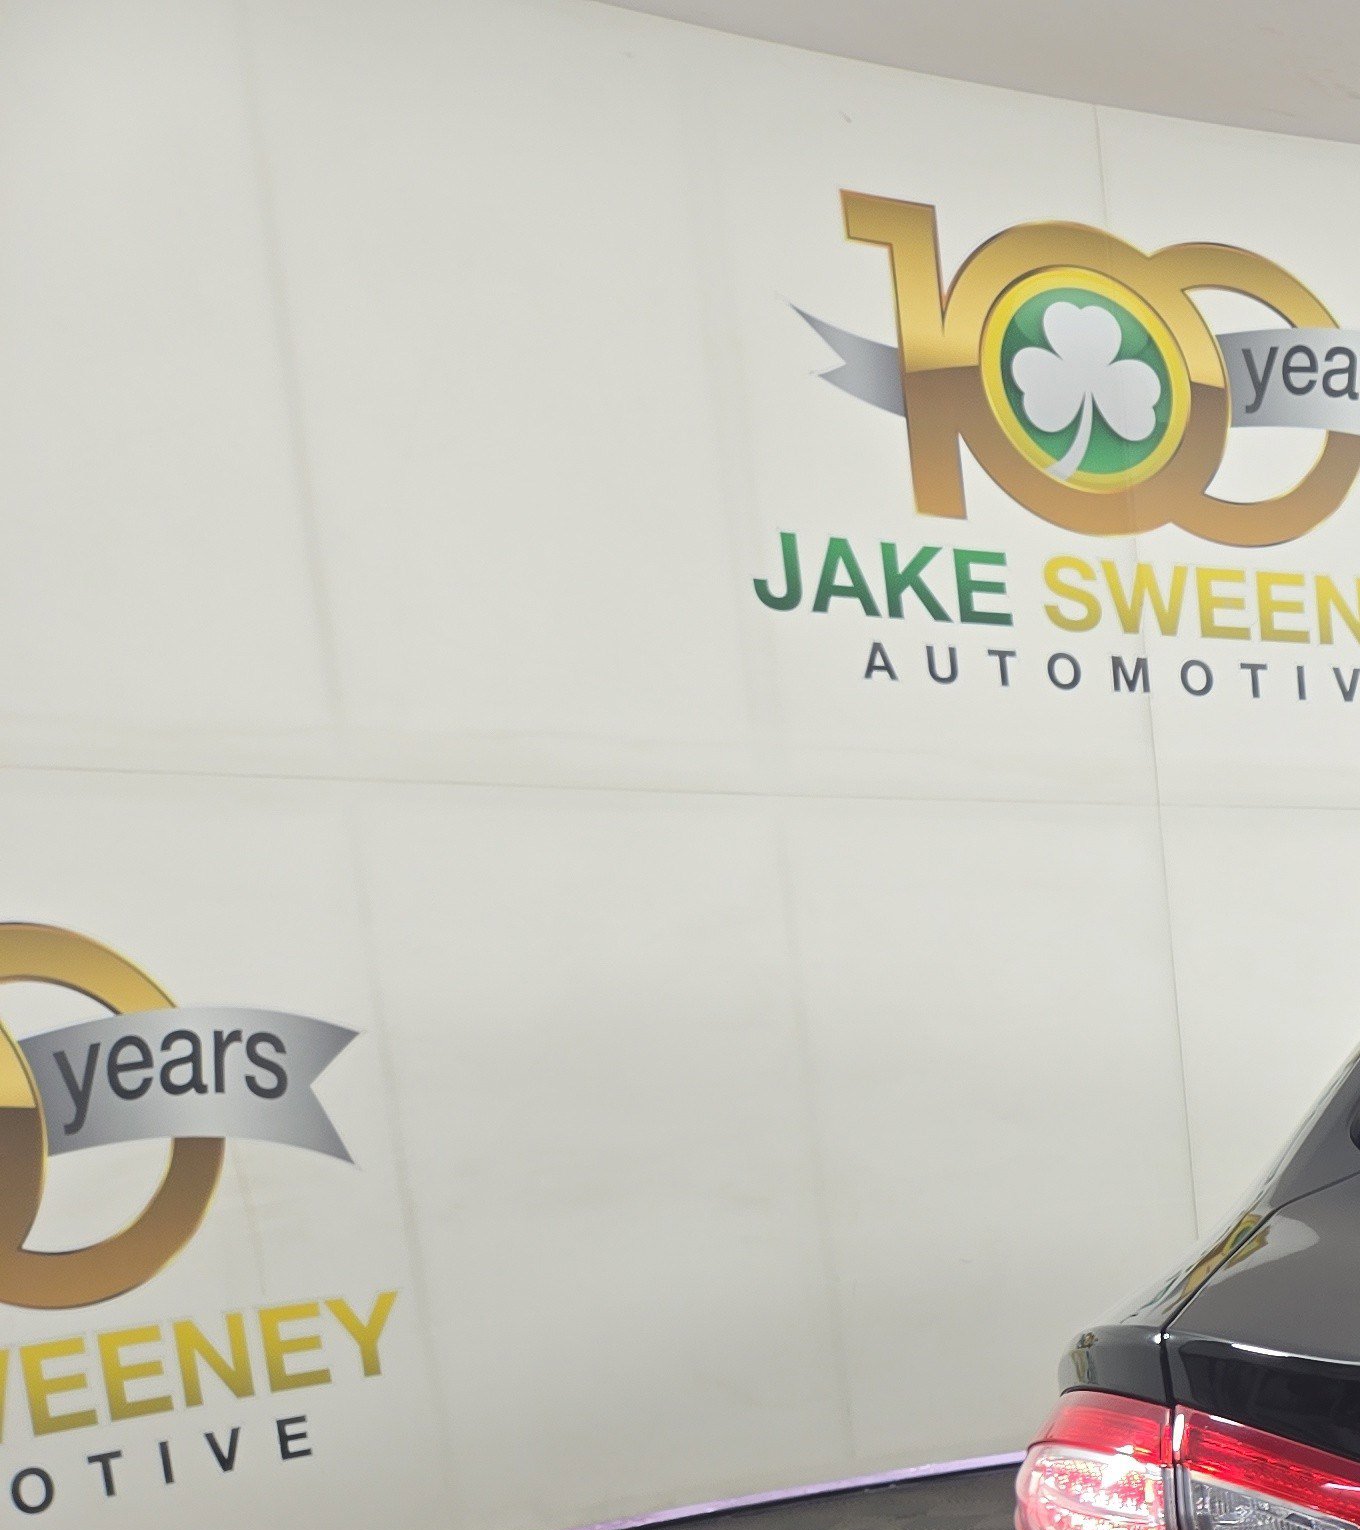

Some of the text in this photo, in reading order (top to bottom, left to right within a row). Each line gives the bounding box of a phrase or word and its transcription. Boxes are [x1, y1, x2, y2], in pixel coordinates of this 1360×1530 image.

[753, 531, 1013, 627] JAKE
[53, 1026, 289, 1136] years
[0, 1291, 399, 1444] EENEY
